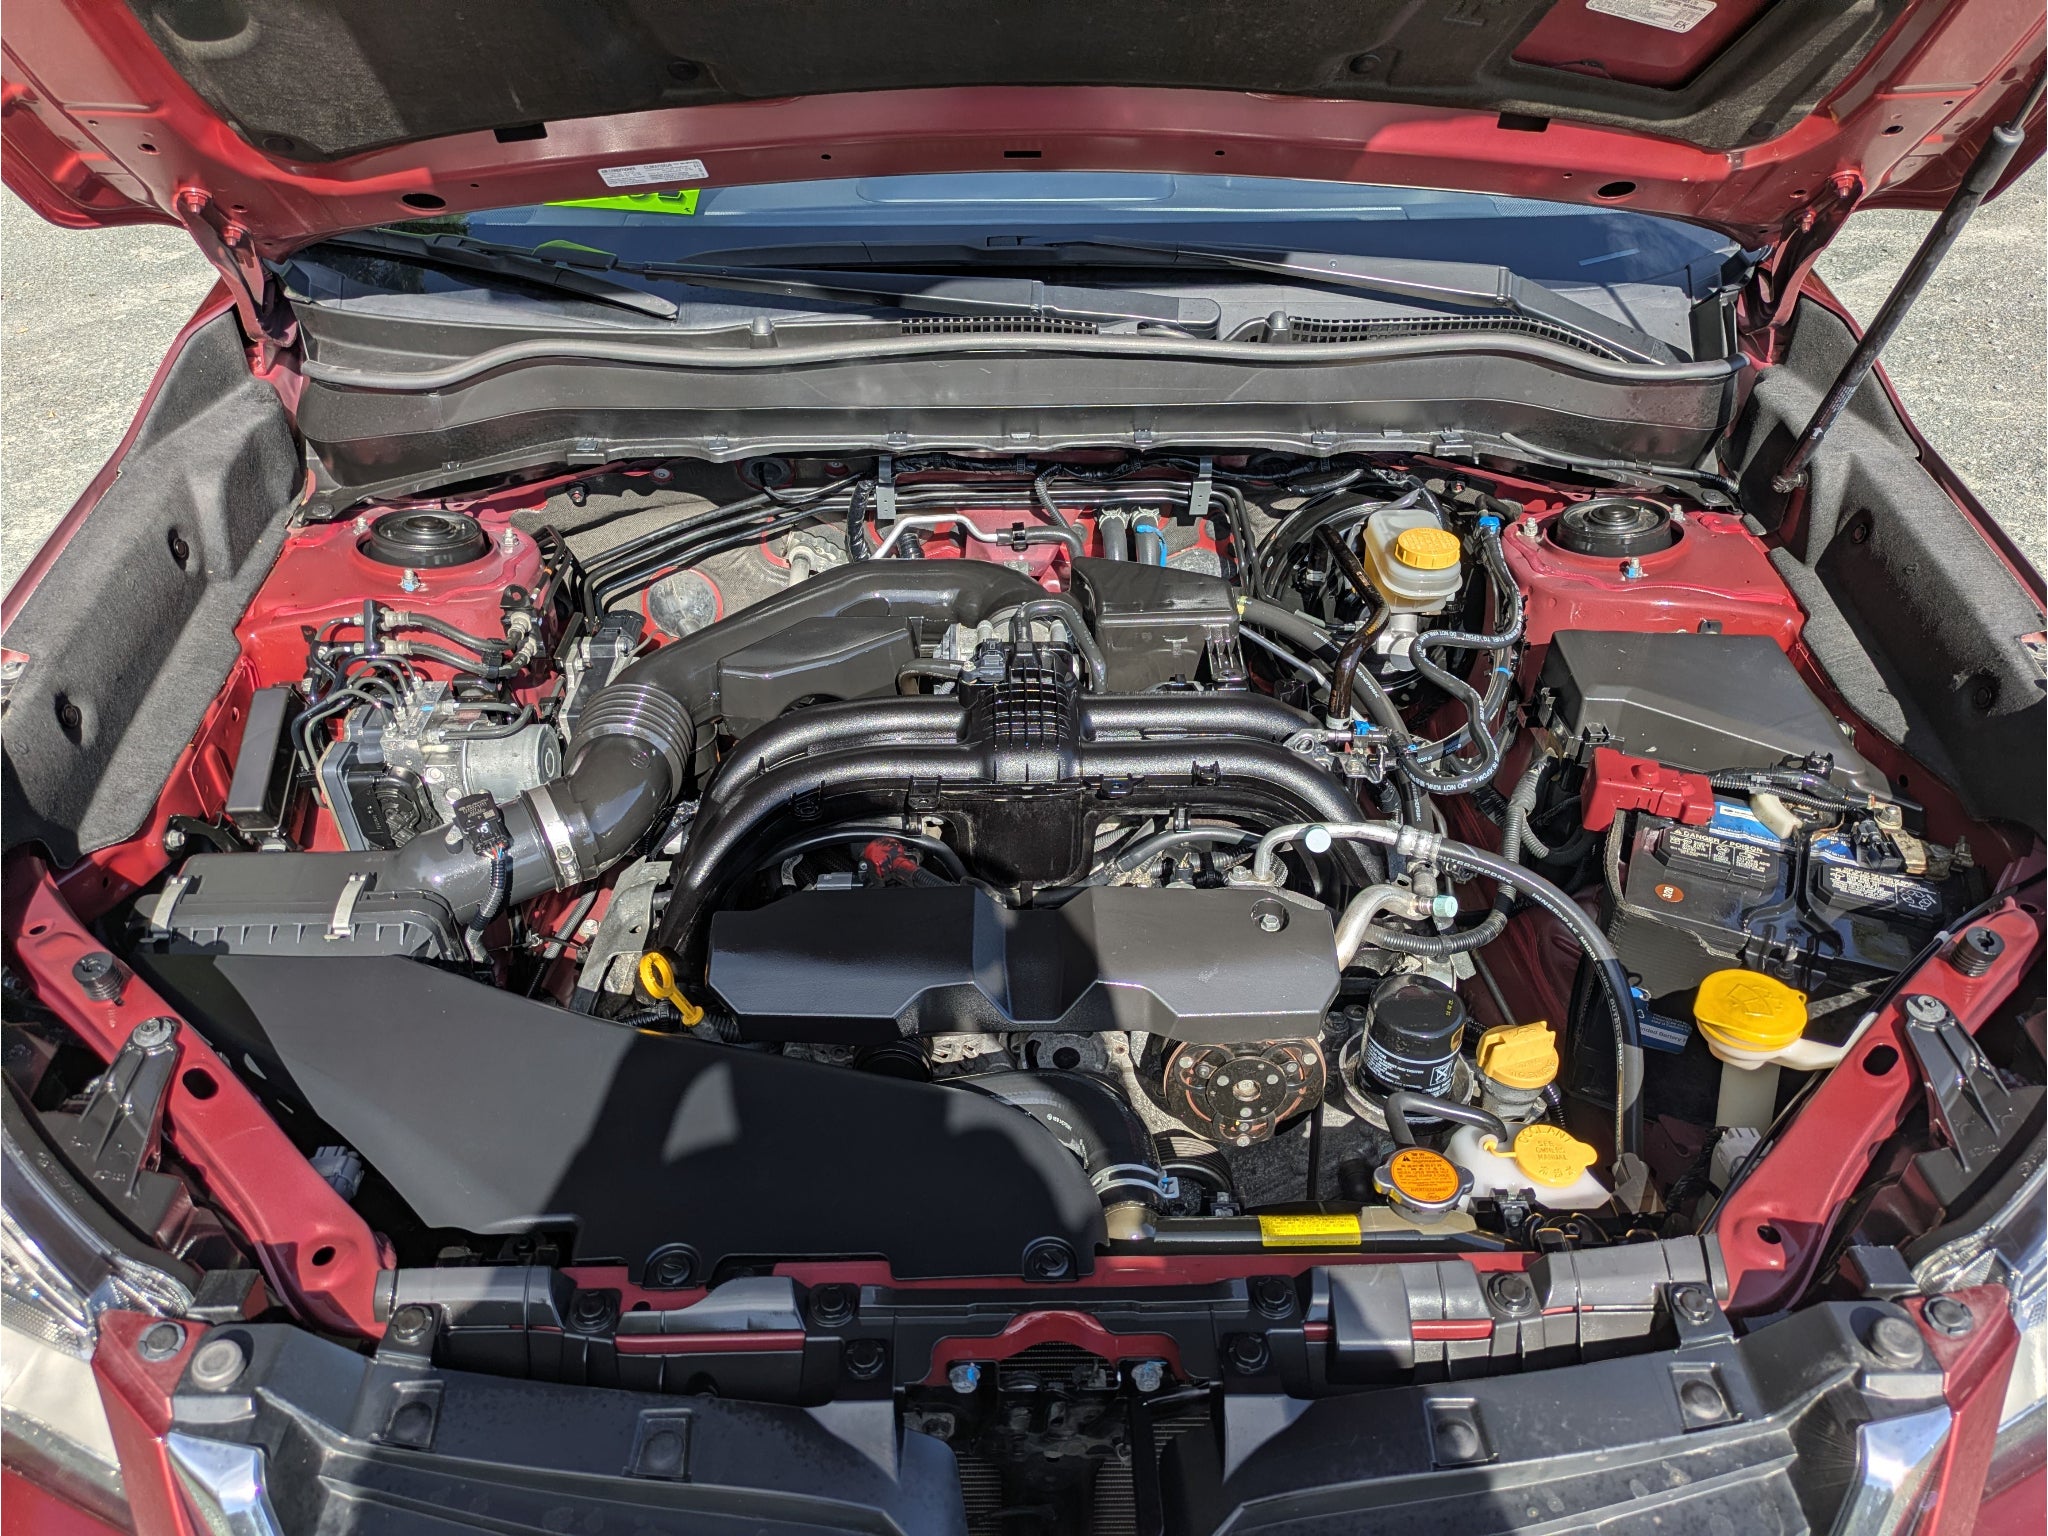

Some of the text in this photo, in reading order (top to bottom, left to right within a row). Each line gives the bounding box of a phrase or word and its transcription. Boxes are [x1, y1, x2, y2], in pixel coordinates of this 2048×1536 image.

[1674, 21, 1690, 29] EK
[1684, 830, 1719, 844] DANGER
[1729, 841, 1763, 854] POISON
